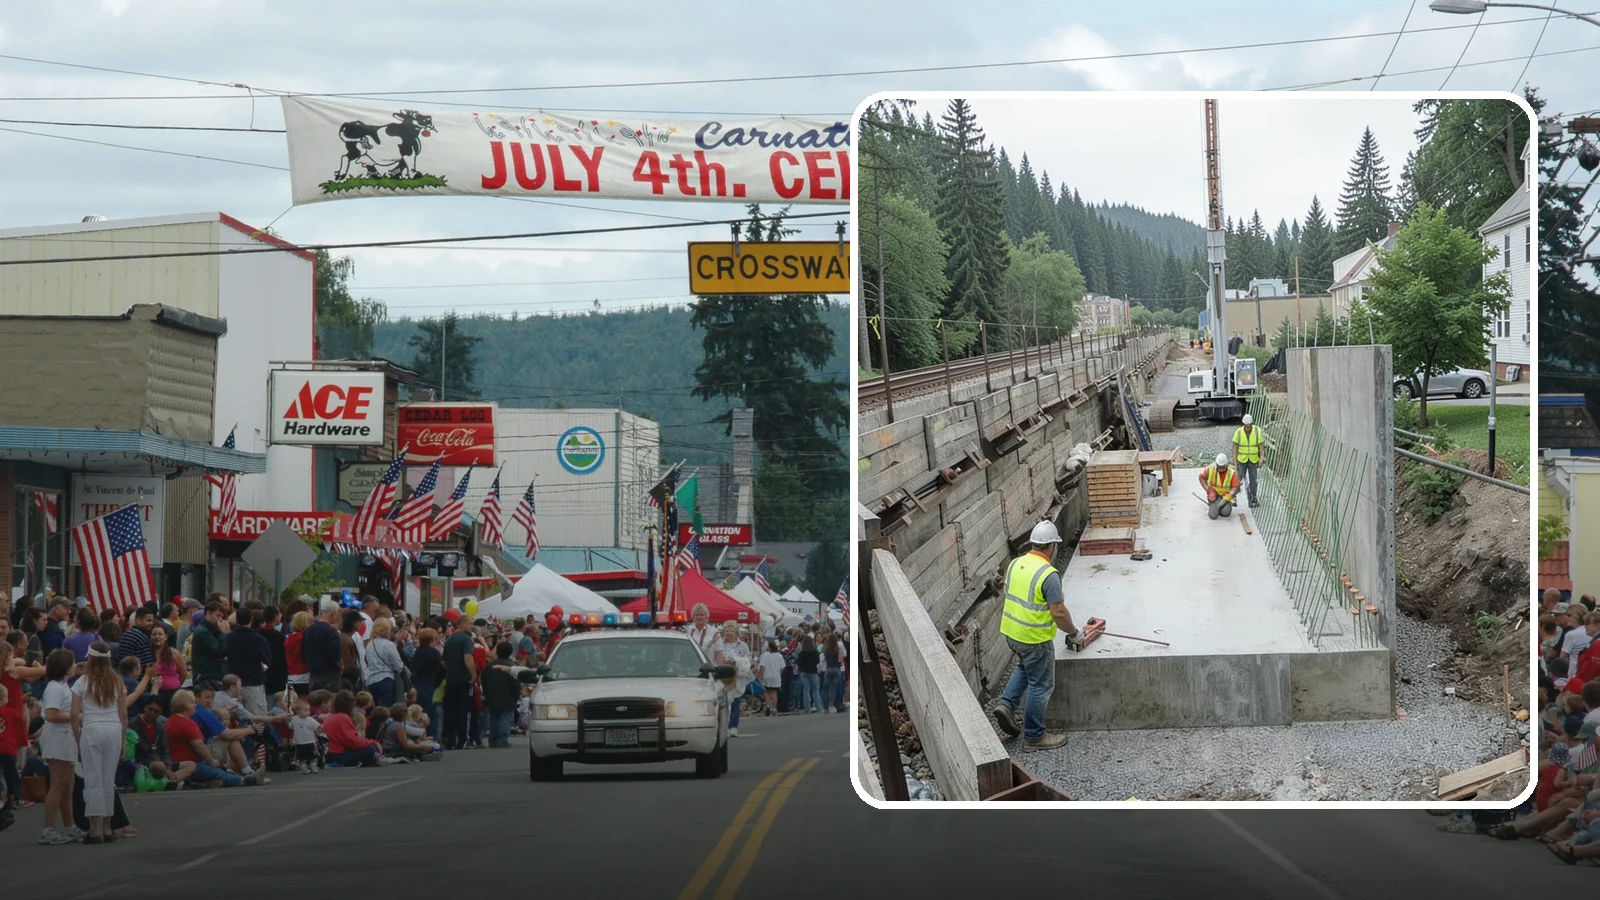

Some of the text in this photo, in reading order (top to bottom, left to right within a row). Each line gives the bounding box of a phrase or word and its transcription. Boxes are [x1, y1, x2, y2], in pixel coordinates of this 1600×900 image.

[695, 121, 850, 150] Carnat
[481, 141, 604, 192] JULY
[633, 150, 746, 198] 4th.
[697, 254, 850, 280] CROSSWA
[283, 380, 373, 420] ACE
[406, 409, 453, 422] CEDAR
[284, 420, 370, 436] Hardware
[416, 427, 477, 447] Coca-Cola
[95, 485, 124, 495] Vincent
[126, 486, 135, 495] de
[137, 486, 155, 495] Paul
[688, 526, 741, 535] CRNATION
[699, 535, 730, 543] GLASS
